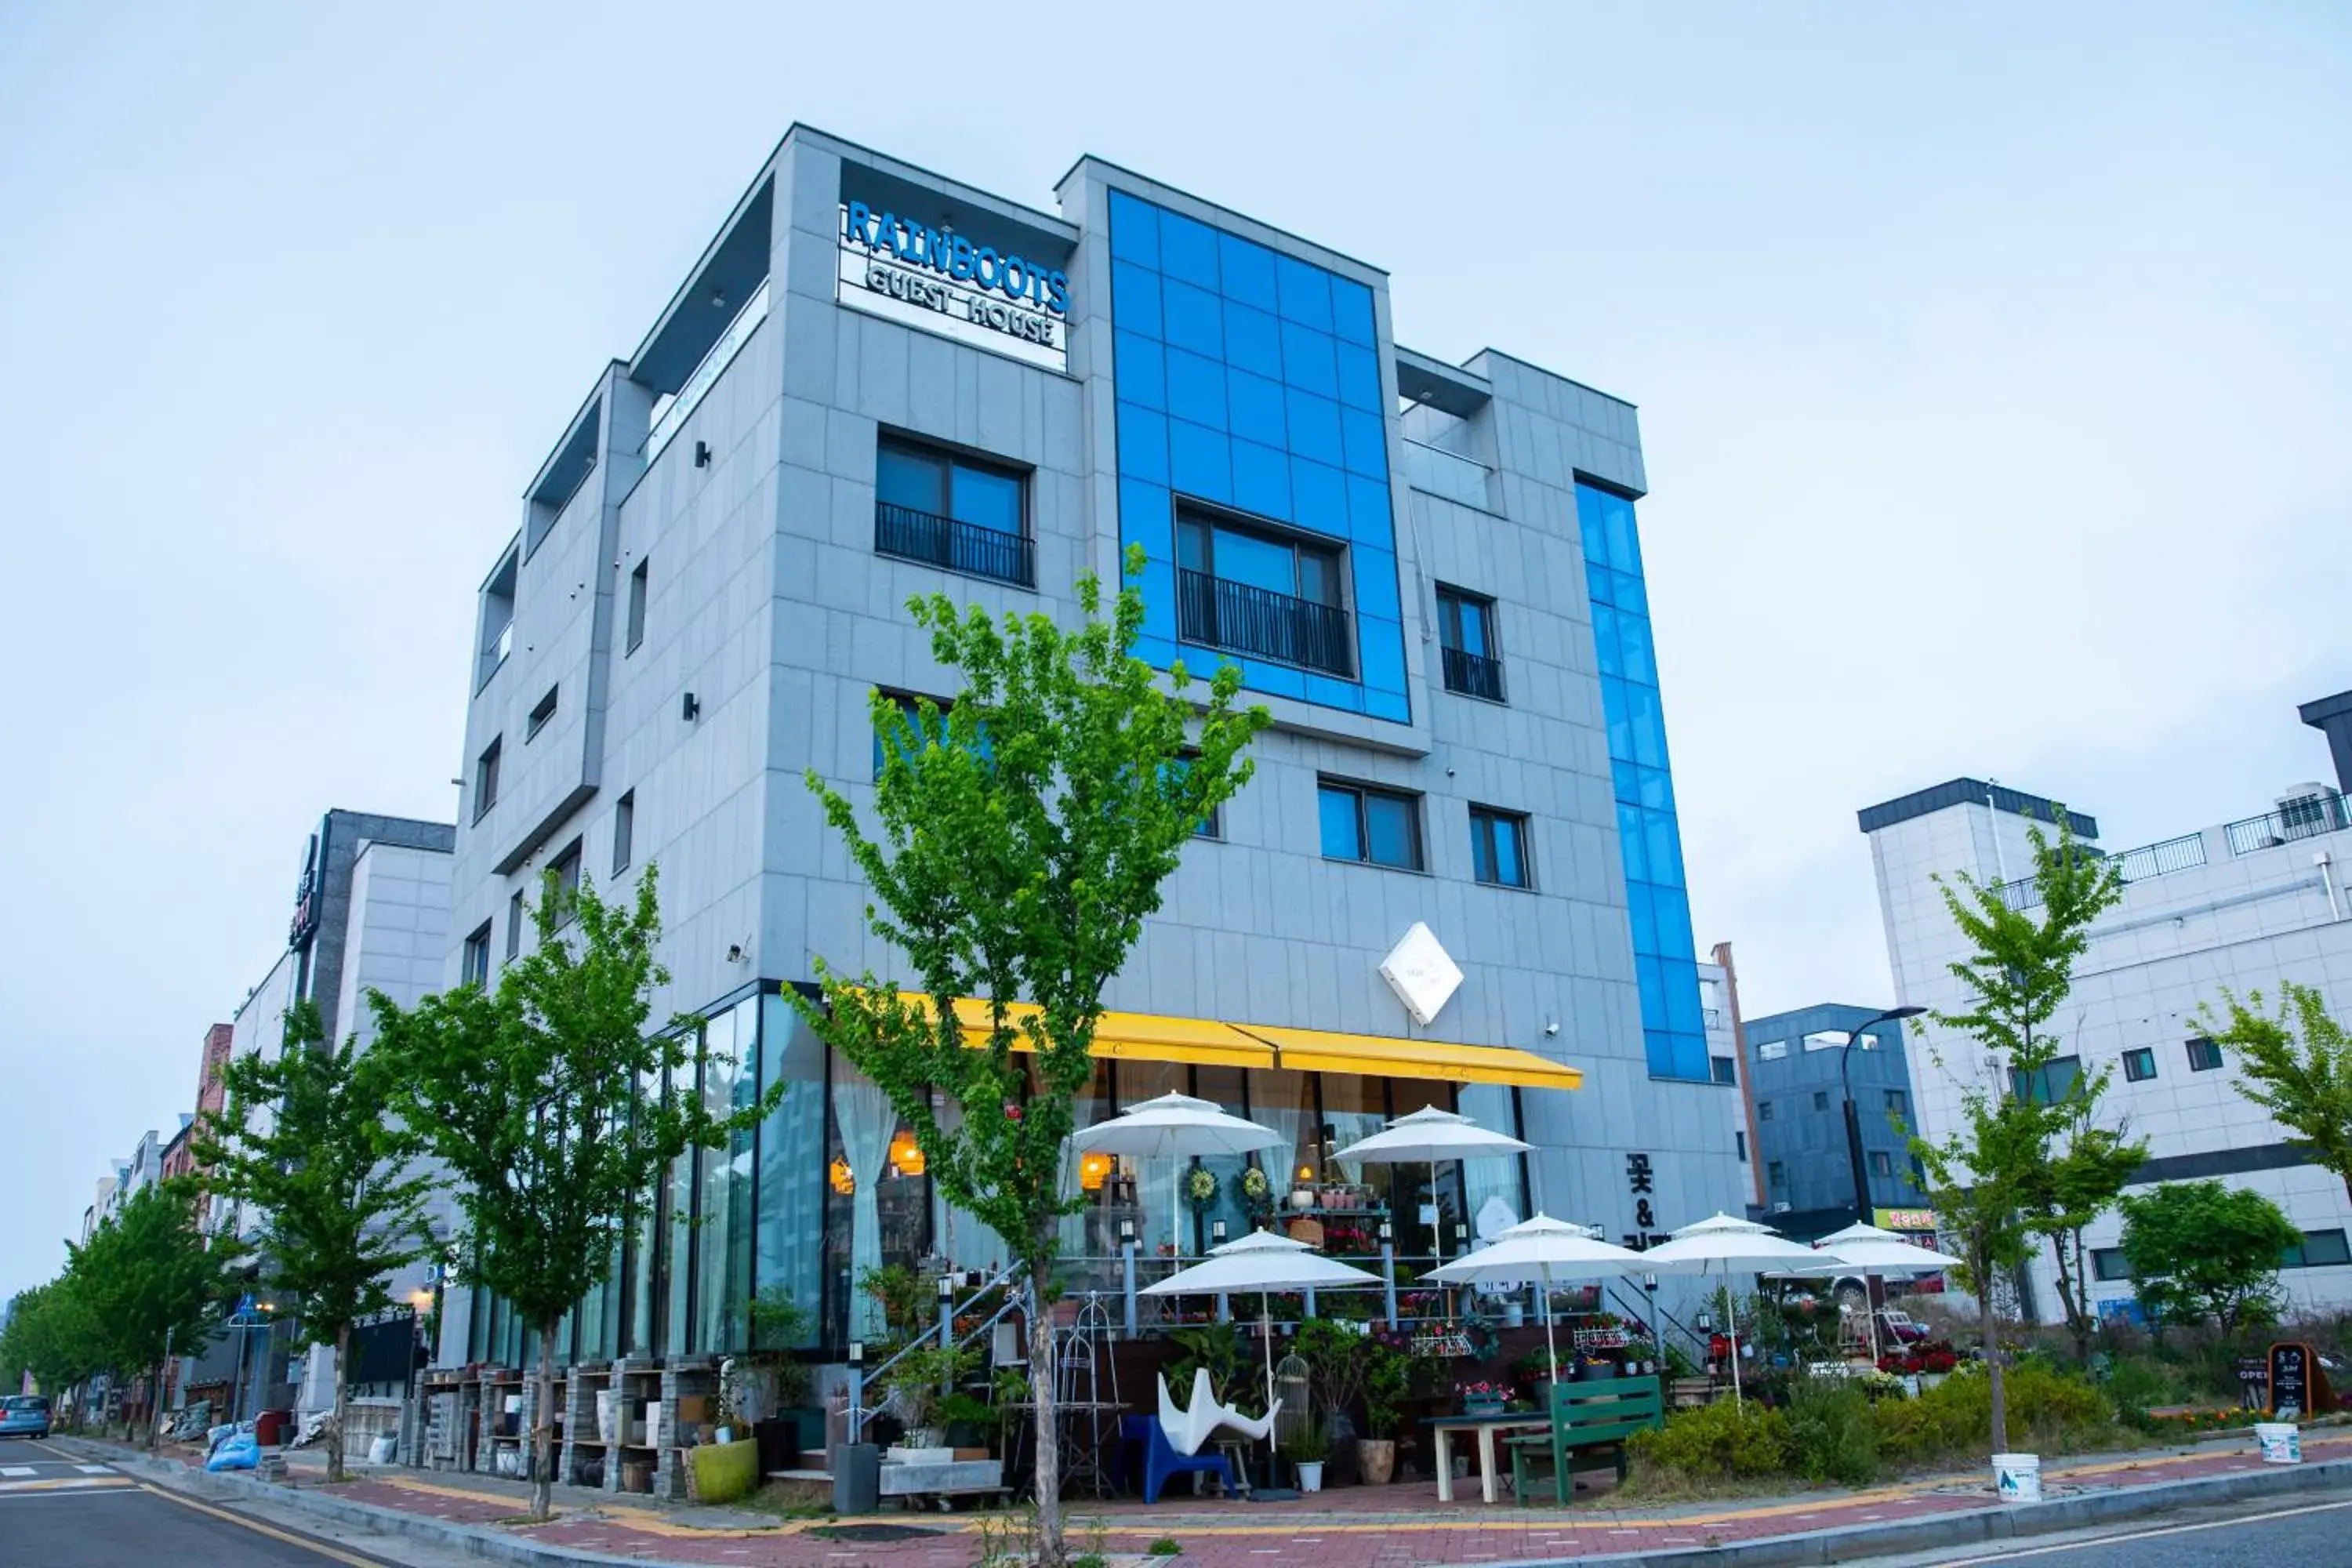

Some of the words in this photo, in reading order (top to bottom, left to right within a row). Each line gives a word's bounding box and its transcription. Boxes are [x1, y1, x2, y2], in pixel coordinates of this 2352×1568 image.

[848, 200, 1071, 314] RAINBOOTS
[866, 265, 953, 311] GUEST
[968, 296, 1054, 345] HOUSE
[1626, 1152, 1653, 1193] 꽃
[1636, 1198, 1655, 1228] &
